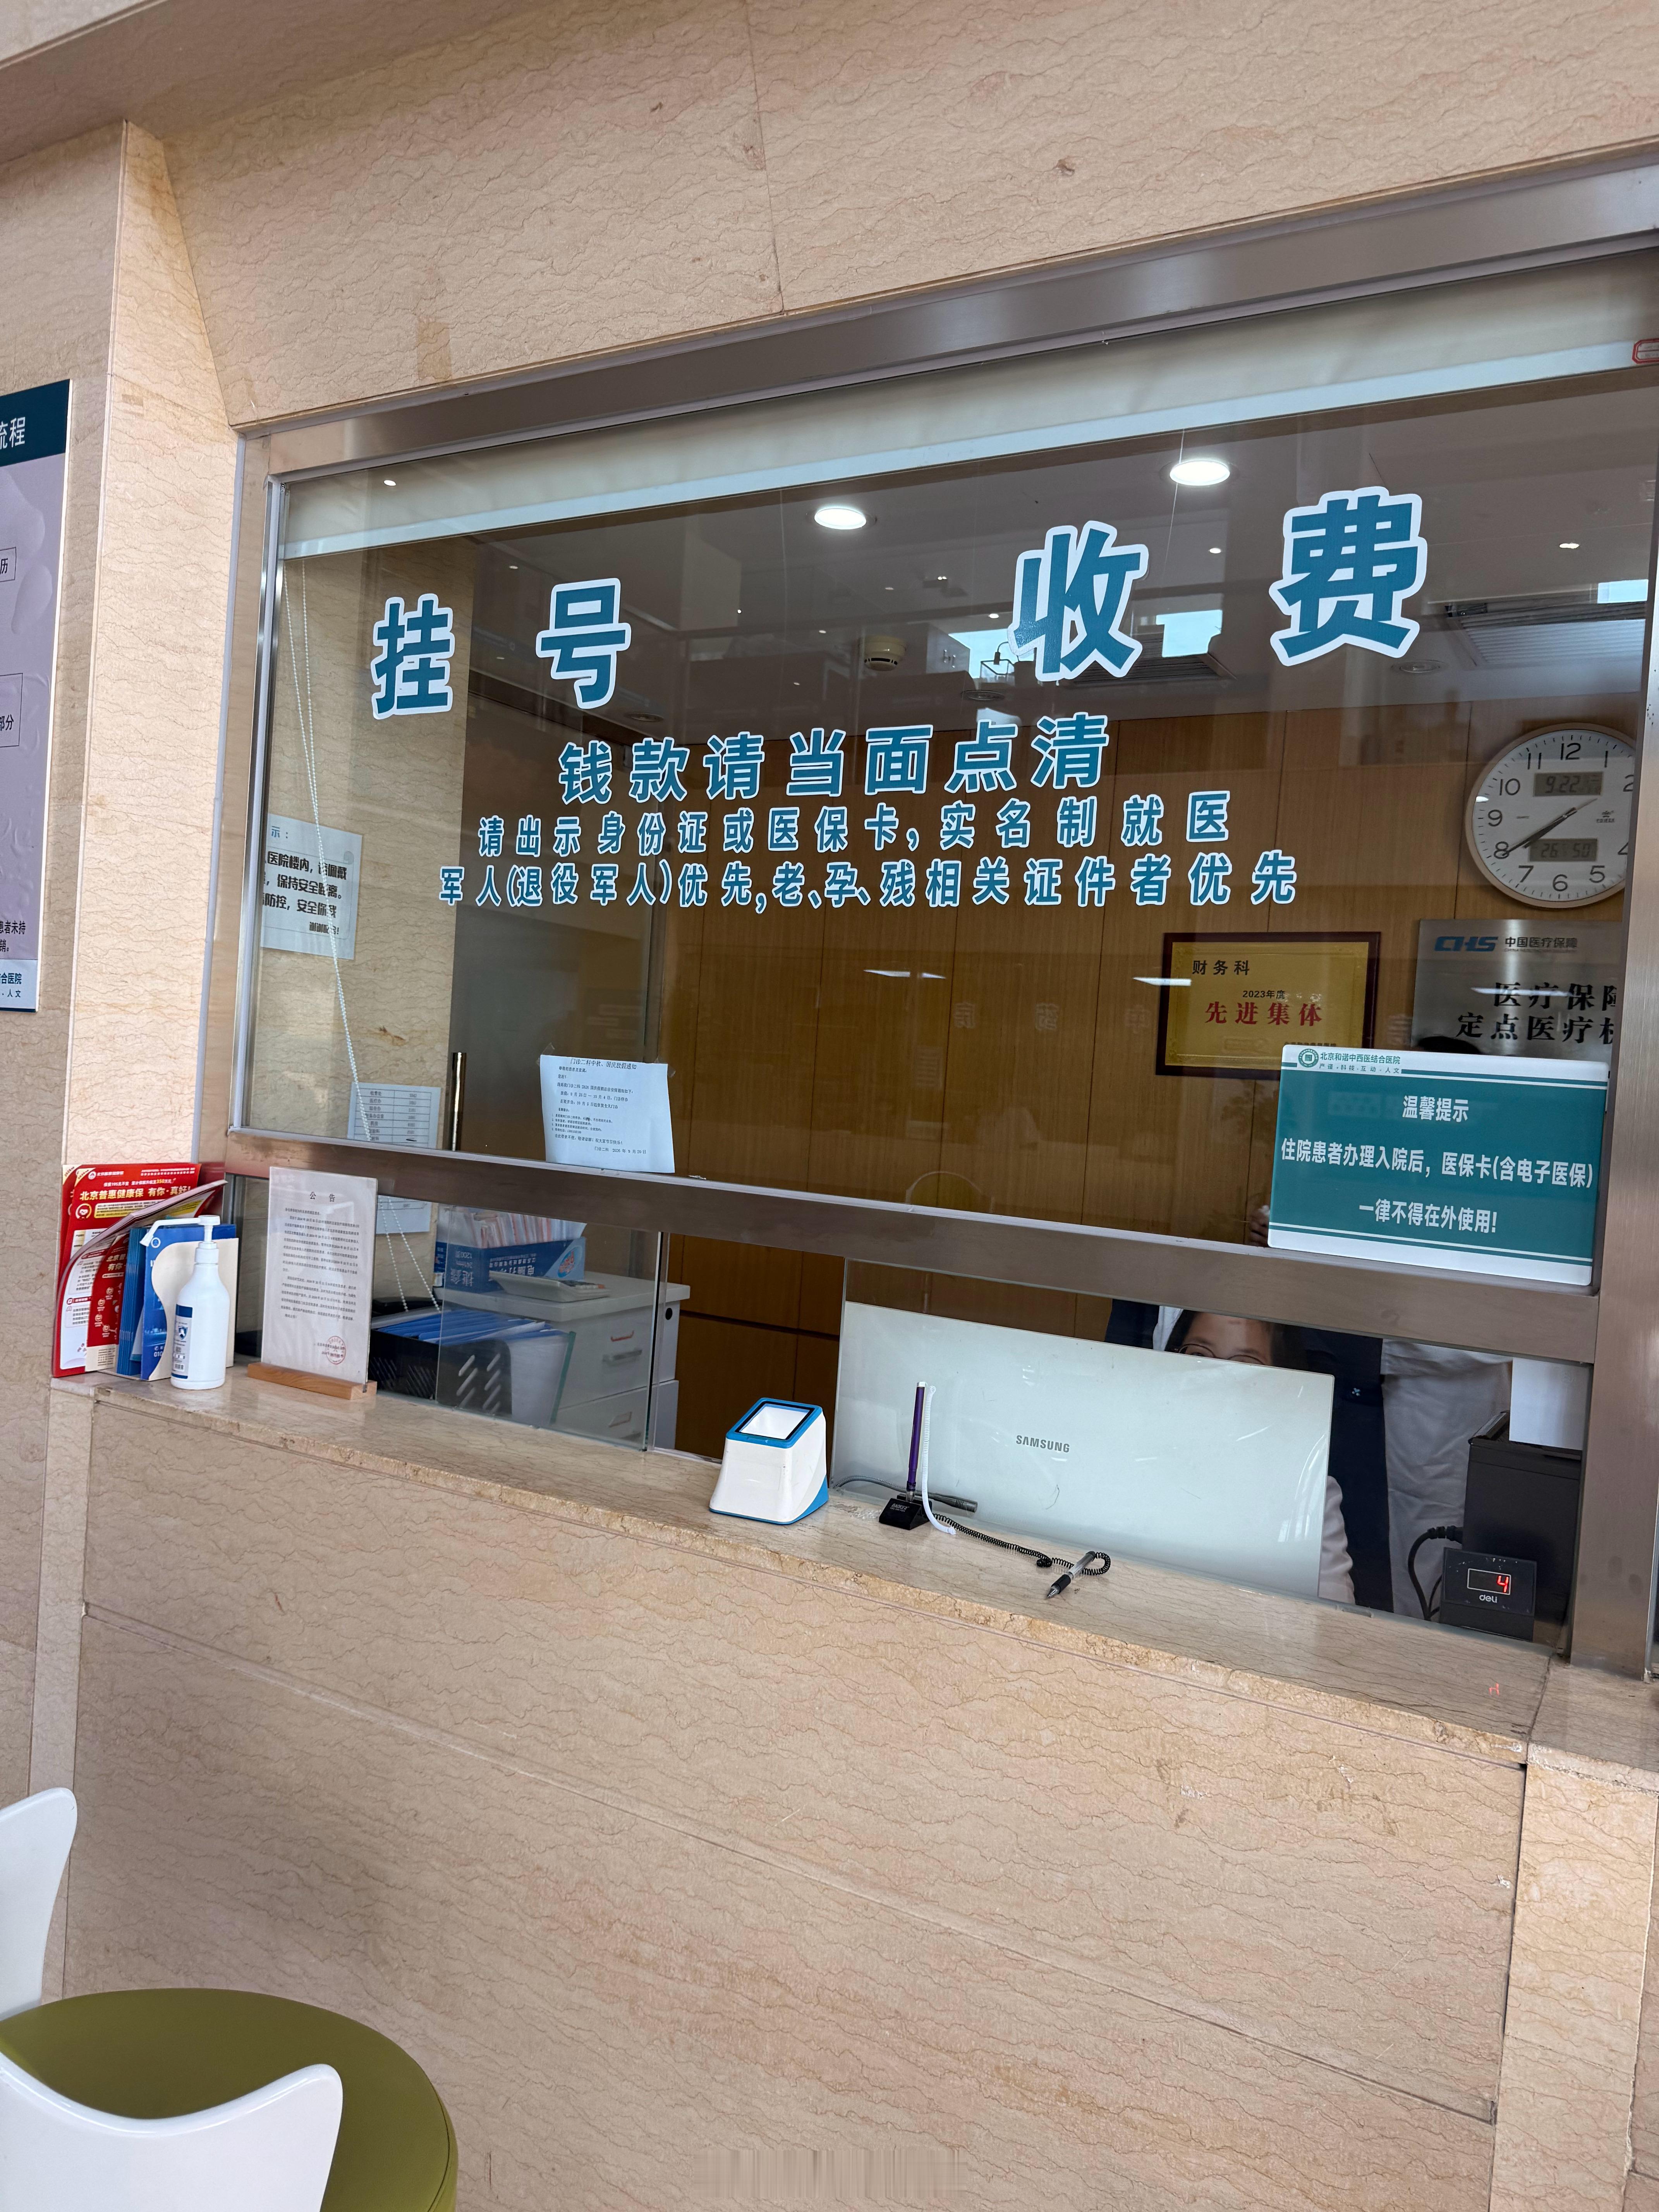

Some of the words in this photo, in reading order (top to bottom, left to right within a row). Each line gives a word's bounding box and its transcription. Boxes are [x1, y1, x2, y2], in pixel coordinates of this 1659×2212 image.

[370, 578, 631, 720] 挂号
[1007, 486, 1427, 681] 收费
[557, 712, 1109, 804] 钱款请当面点清
[1560, 742, 1581, 760] 12
[1604, 750, 1608, 768] 1
[1527, 752, 1542, 770] 11
[1499, 778, 1521, 796] 10
[1487, 809, 1503, 827] 9
[1493, 841, 1510, 859] 8
[265, 851, 347, 880] 医院楼内，请佩戴
[1518, 865, 1534, 883] 7
[1589, 865, 1605, 883] 5
[263, 872, 342, 900] ，保持安全距离。
[1553, 874, 1568, 891] 6
[1192, 960, 1250, 976] 财务科
[0, 973, 22, 984] 合医院
[1242, 989, 1286, 1000] 2023年度
[1204, 1001, 1322, 1027] 先进集体
[1320, 1052, 1401, 1065] 北京和谐中西医结合医院
[1402, 1095, 1470, 1123] 温馨提示
[79, 1188, 144, 1201] 北京普惠健康保
[1016, 1435, 1070, 1453] SAMSUNG
[1497, 1575, 1509, 1593] 4
[1479, 1594, 1497, 1603] deli
